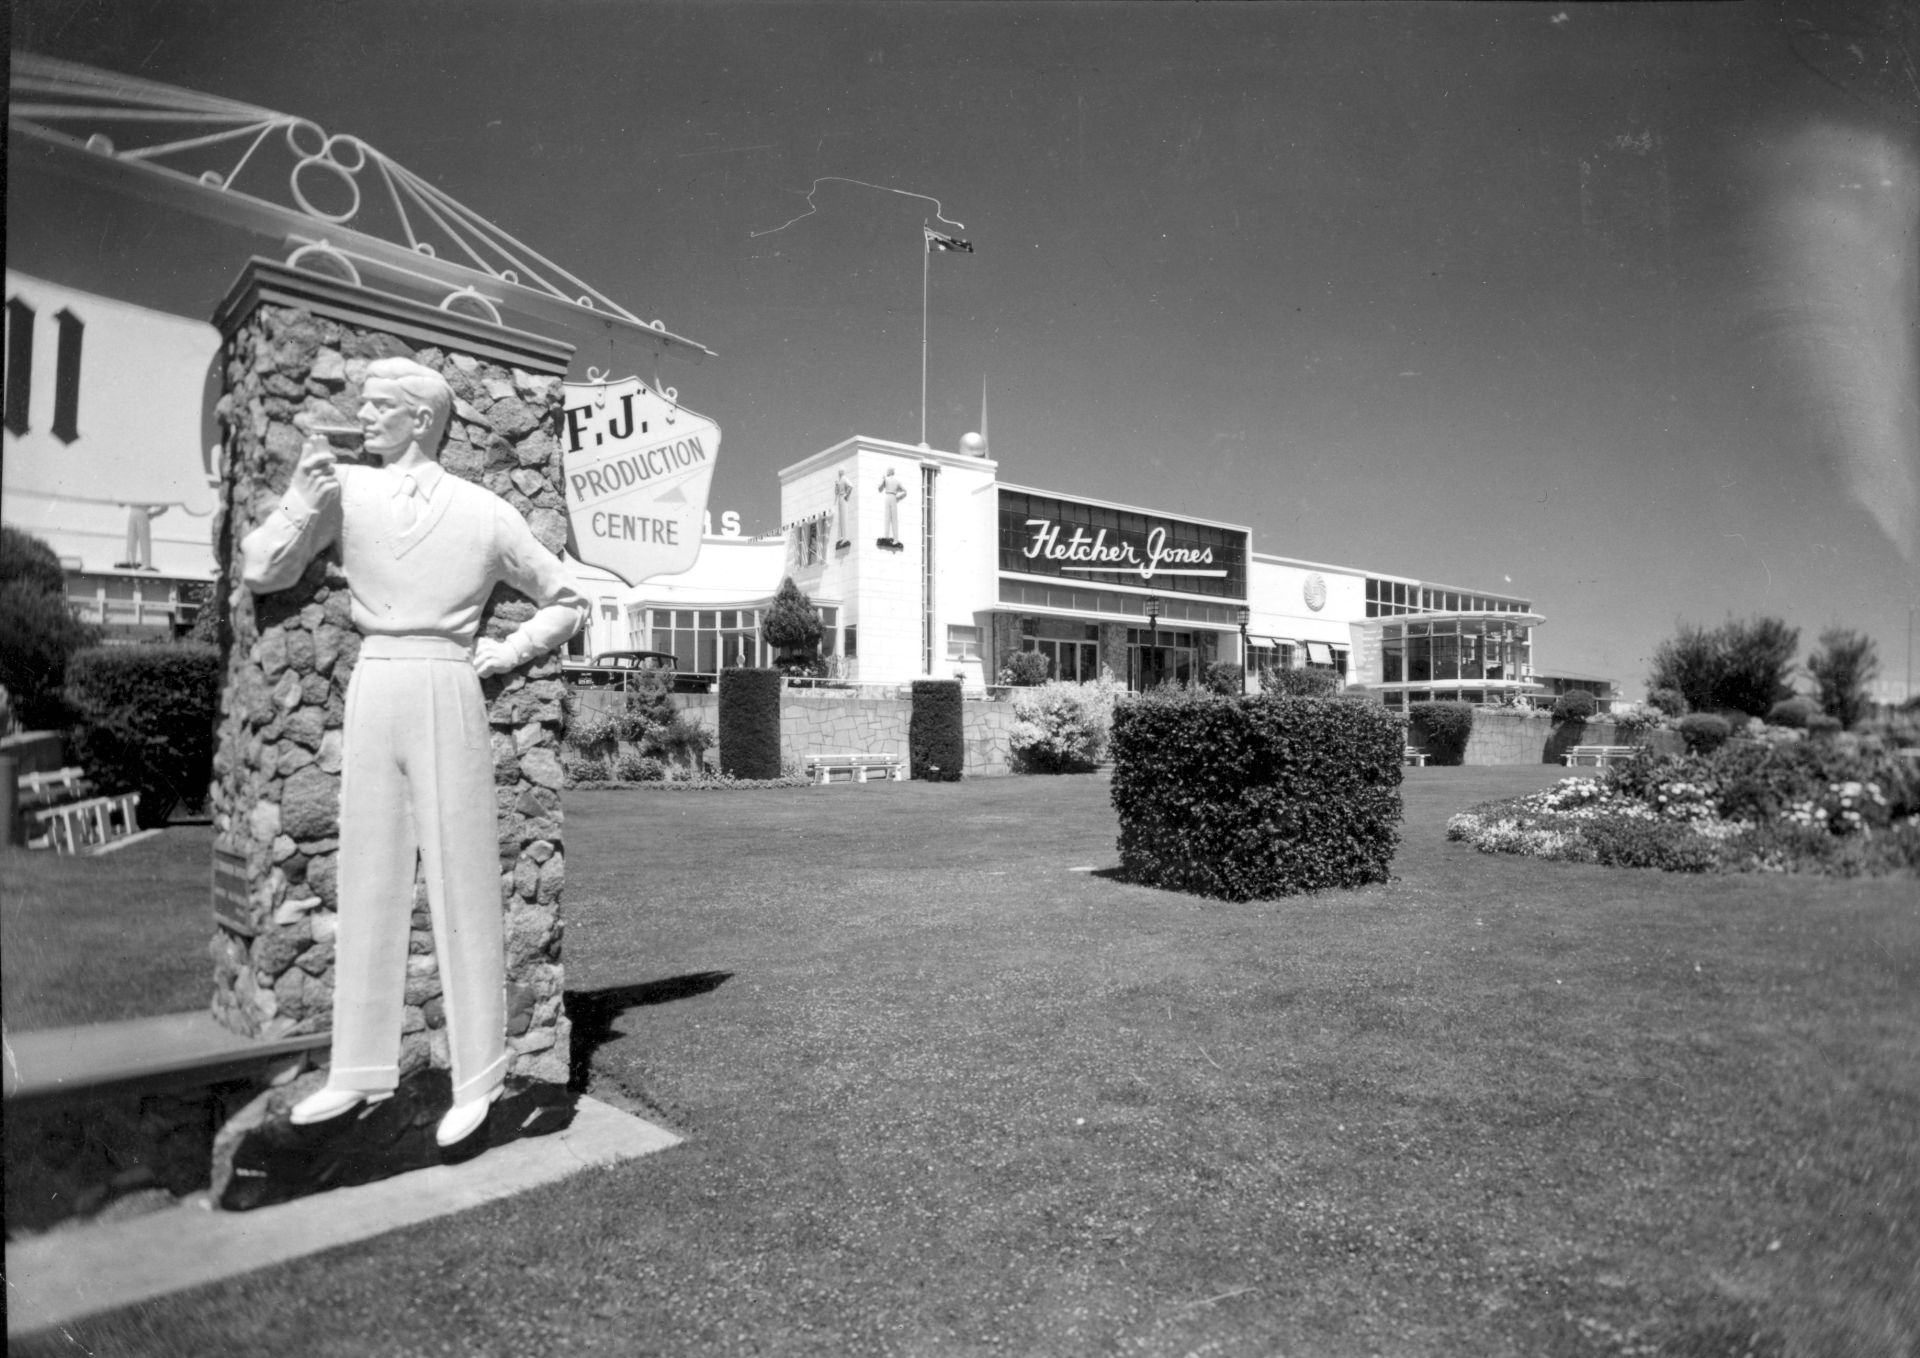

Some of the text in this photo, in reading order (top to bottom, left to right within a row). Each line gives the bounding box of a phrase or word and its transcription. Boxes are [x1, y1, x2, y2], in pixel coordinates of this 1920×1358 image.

[570, 436, 706, 502] PRODUCTION
[591, 511, 680, 546] CENTRE
[1023, 518, 1214, 579] Fletcher Jones
